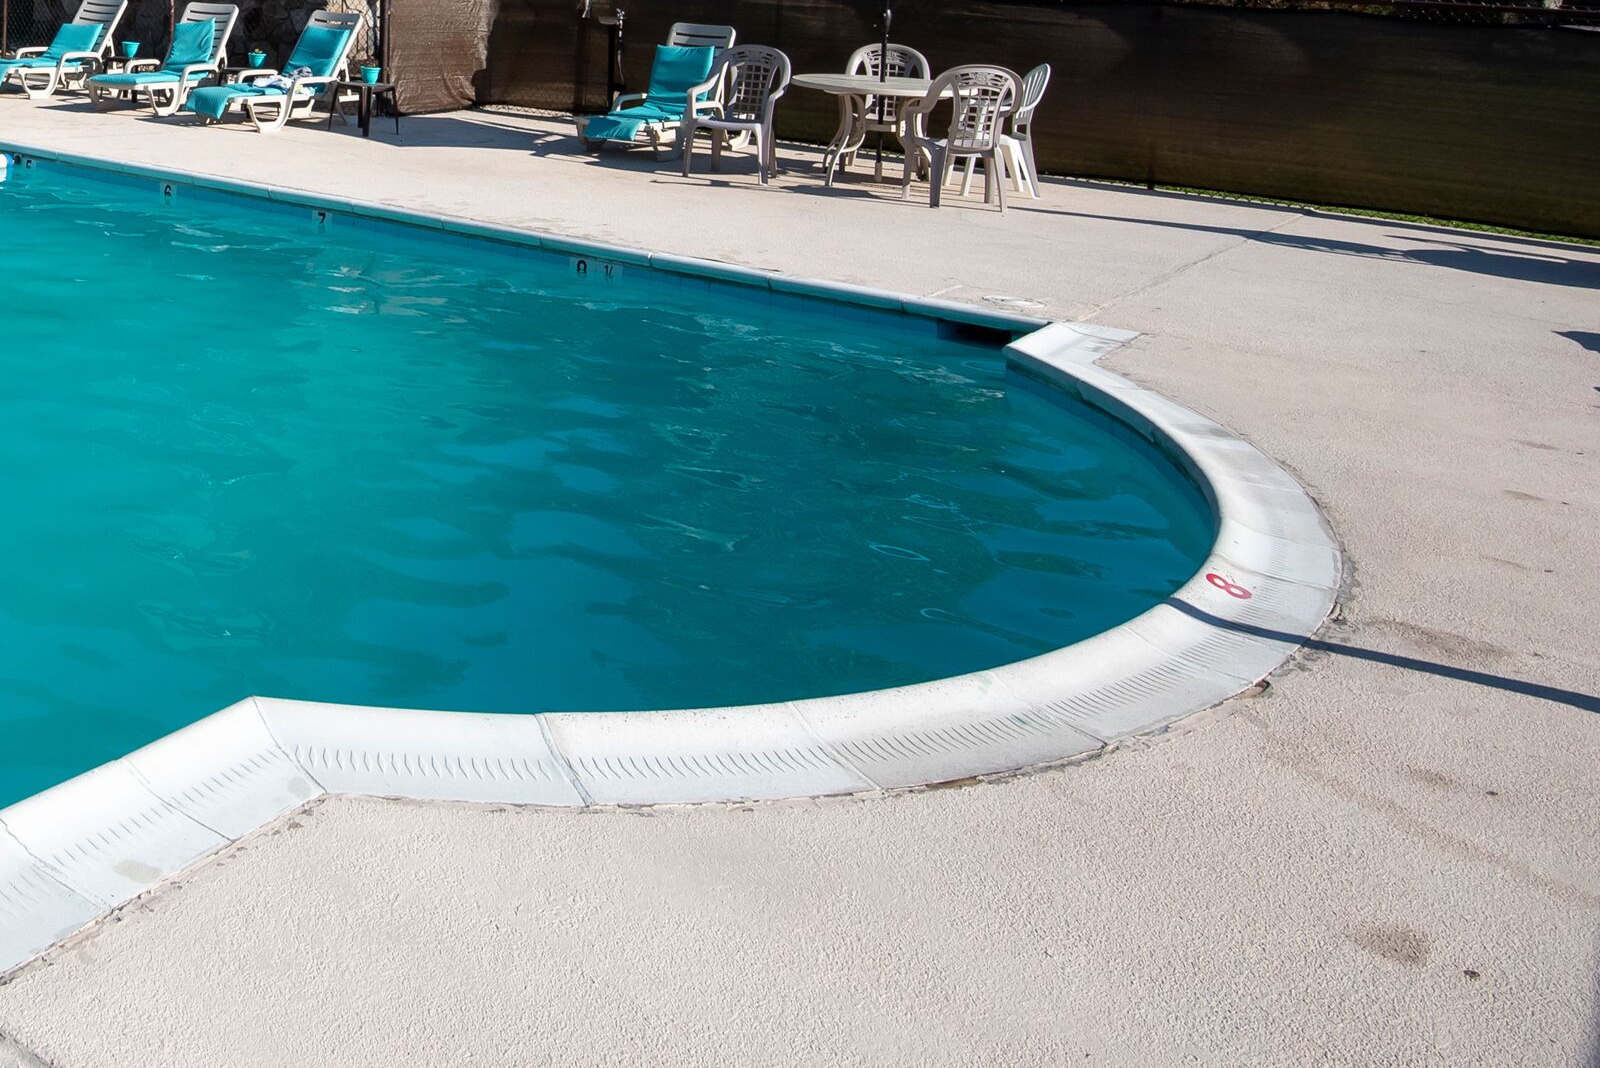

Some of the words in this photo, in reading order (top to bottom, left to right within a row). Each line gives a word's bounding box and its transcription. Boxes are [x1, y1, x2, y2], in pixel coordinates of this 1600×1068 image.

[164, 184, 172, 197] 6
[318, 211, 326, 224] 7
[1205, 573, 1253, 600] 8
